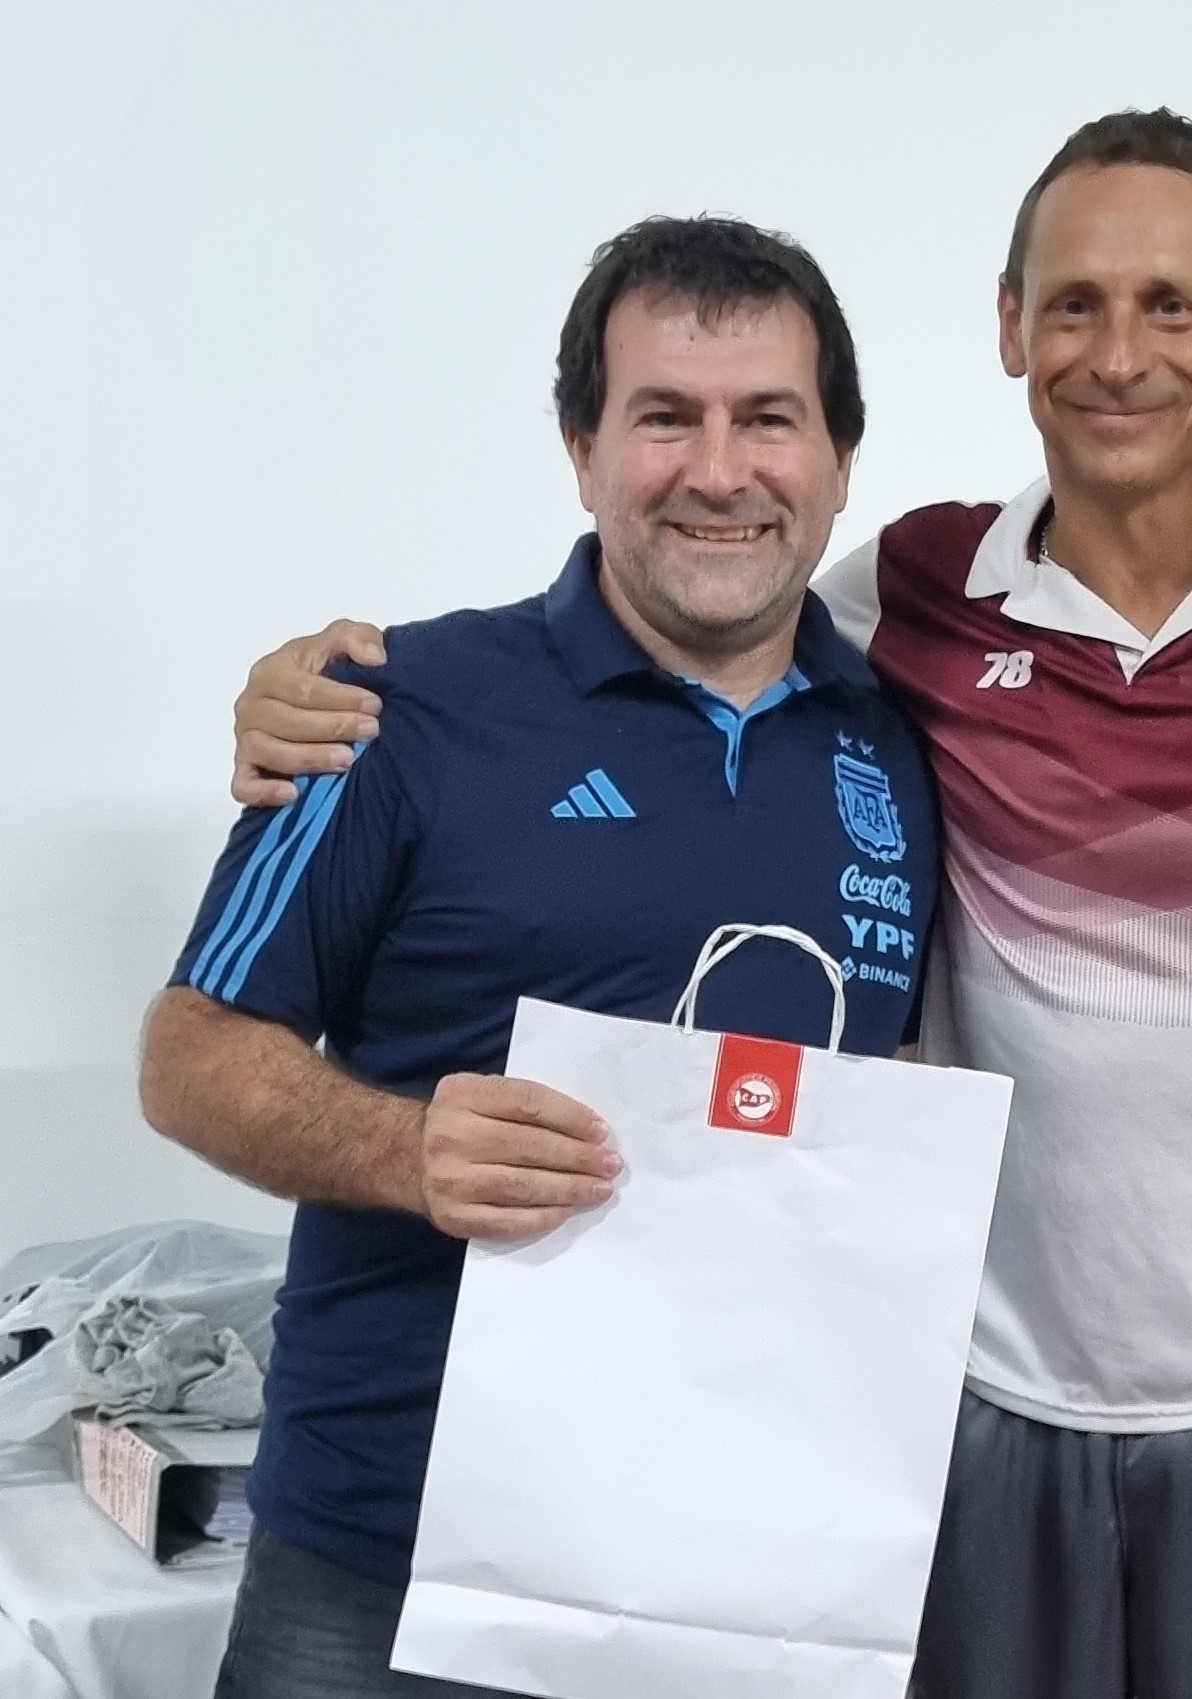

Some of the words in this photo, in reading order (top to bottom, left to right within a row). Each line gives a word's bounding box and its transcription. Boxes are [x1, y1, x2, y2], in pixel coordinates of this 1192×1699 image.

[976, 650, 1034, 689] 78
[841, 914, 914, 960] YPF
[741, 1093, 767, 1104] CAP
